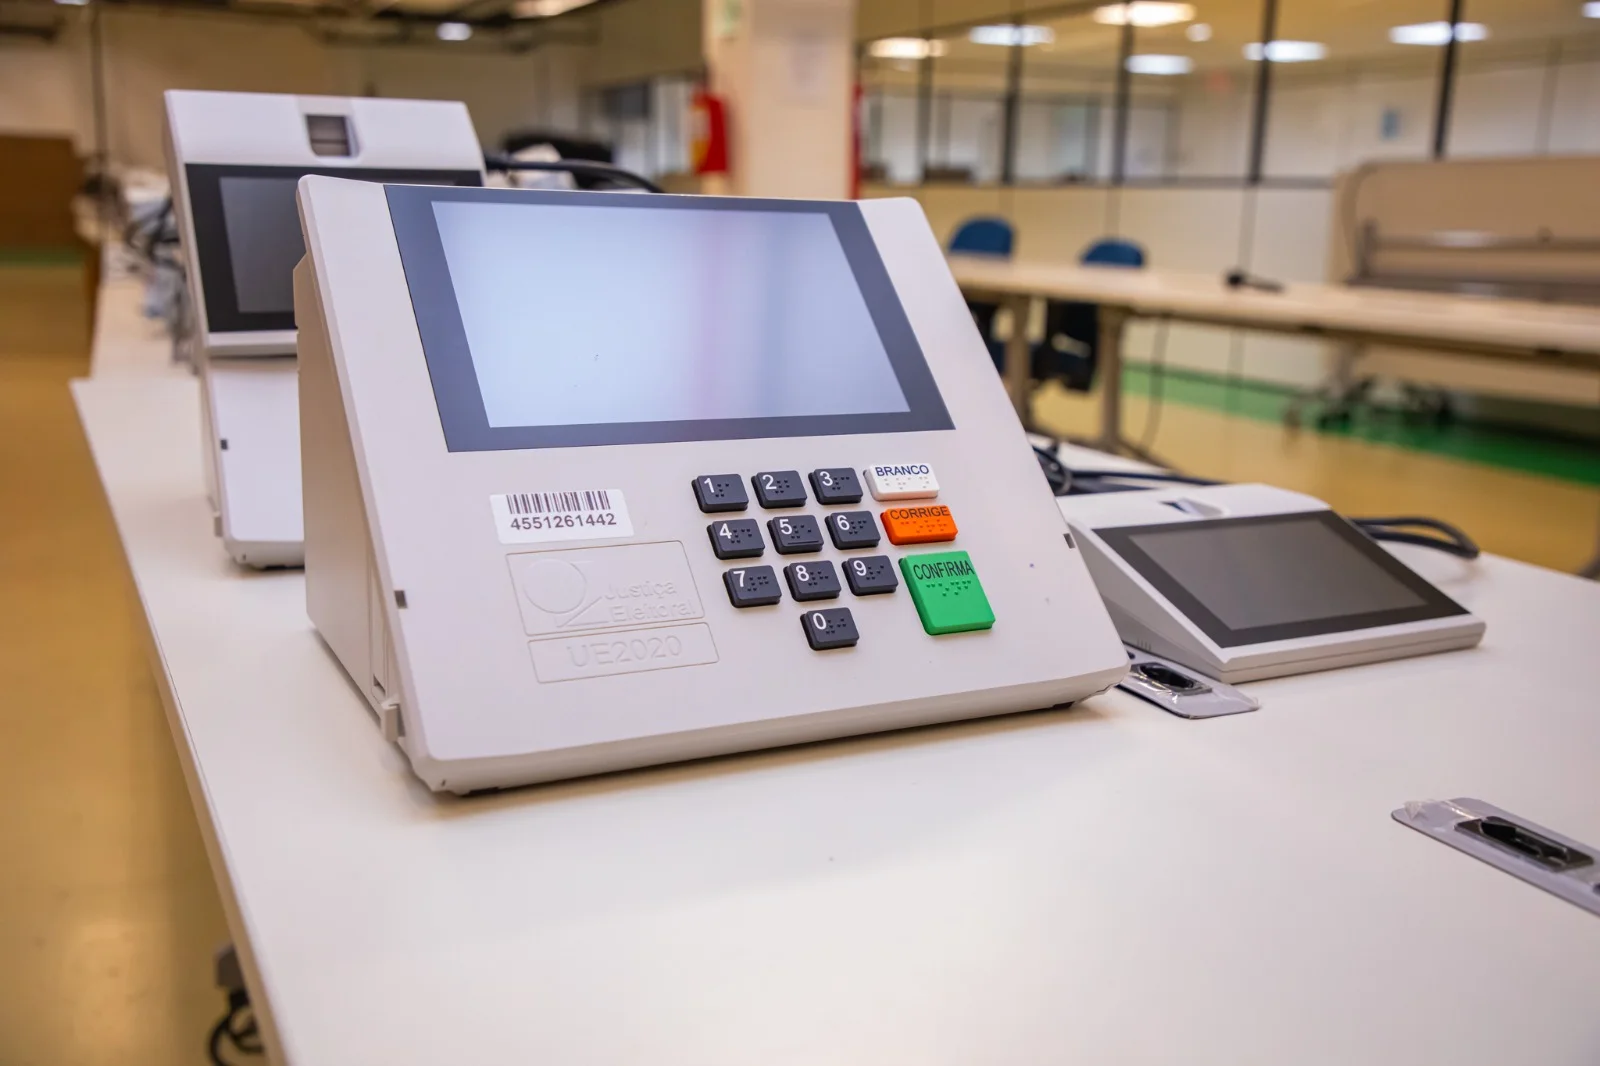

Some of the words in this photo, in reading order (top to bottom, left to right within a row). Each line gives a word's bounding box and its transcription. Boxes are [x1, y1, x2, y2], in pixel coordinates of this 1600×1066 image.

[821, 471, 834, 486] 3
[874, 464, 930, 478] BRANCO
[703, 478, 715, 493] 1
[762, 474, 777, 490] 2
[510, 512, 617, 531] 4551261442
[889, 505, 951, 521] CORRIGE
[719, 523, 732, 539] 4
[780, 518, 792, 535] 5
[837, 515, 850, 531] 6
[797, 564, 810, 582] 8
[853, 559, 867, 576] 9
[913, 560, 975, 581] CONFIRMA
[733, 570, 746, 588] 7
[602, 580, 677, 602] Justiça
[609, 601, 696, 623] Eleitoral
[812, 612, 827, 630] 0
[566, 634, 682, 668] UE2020
